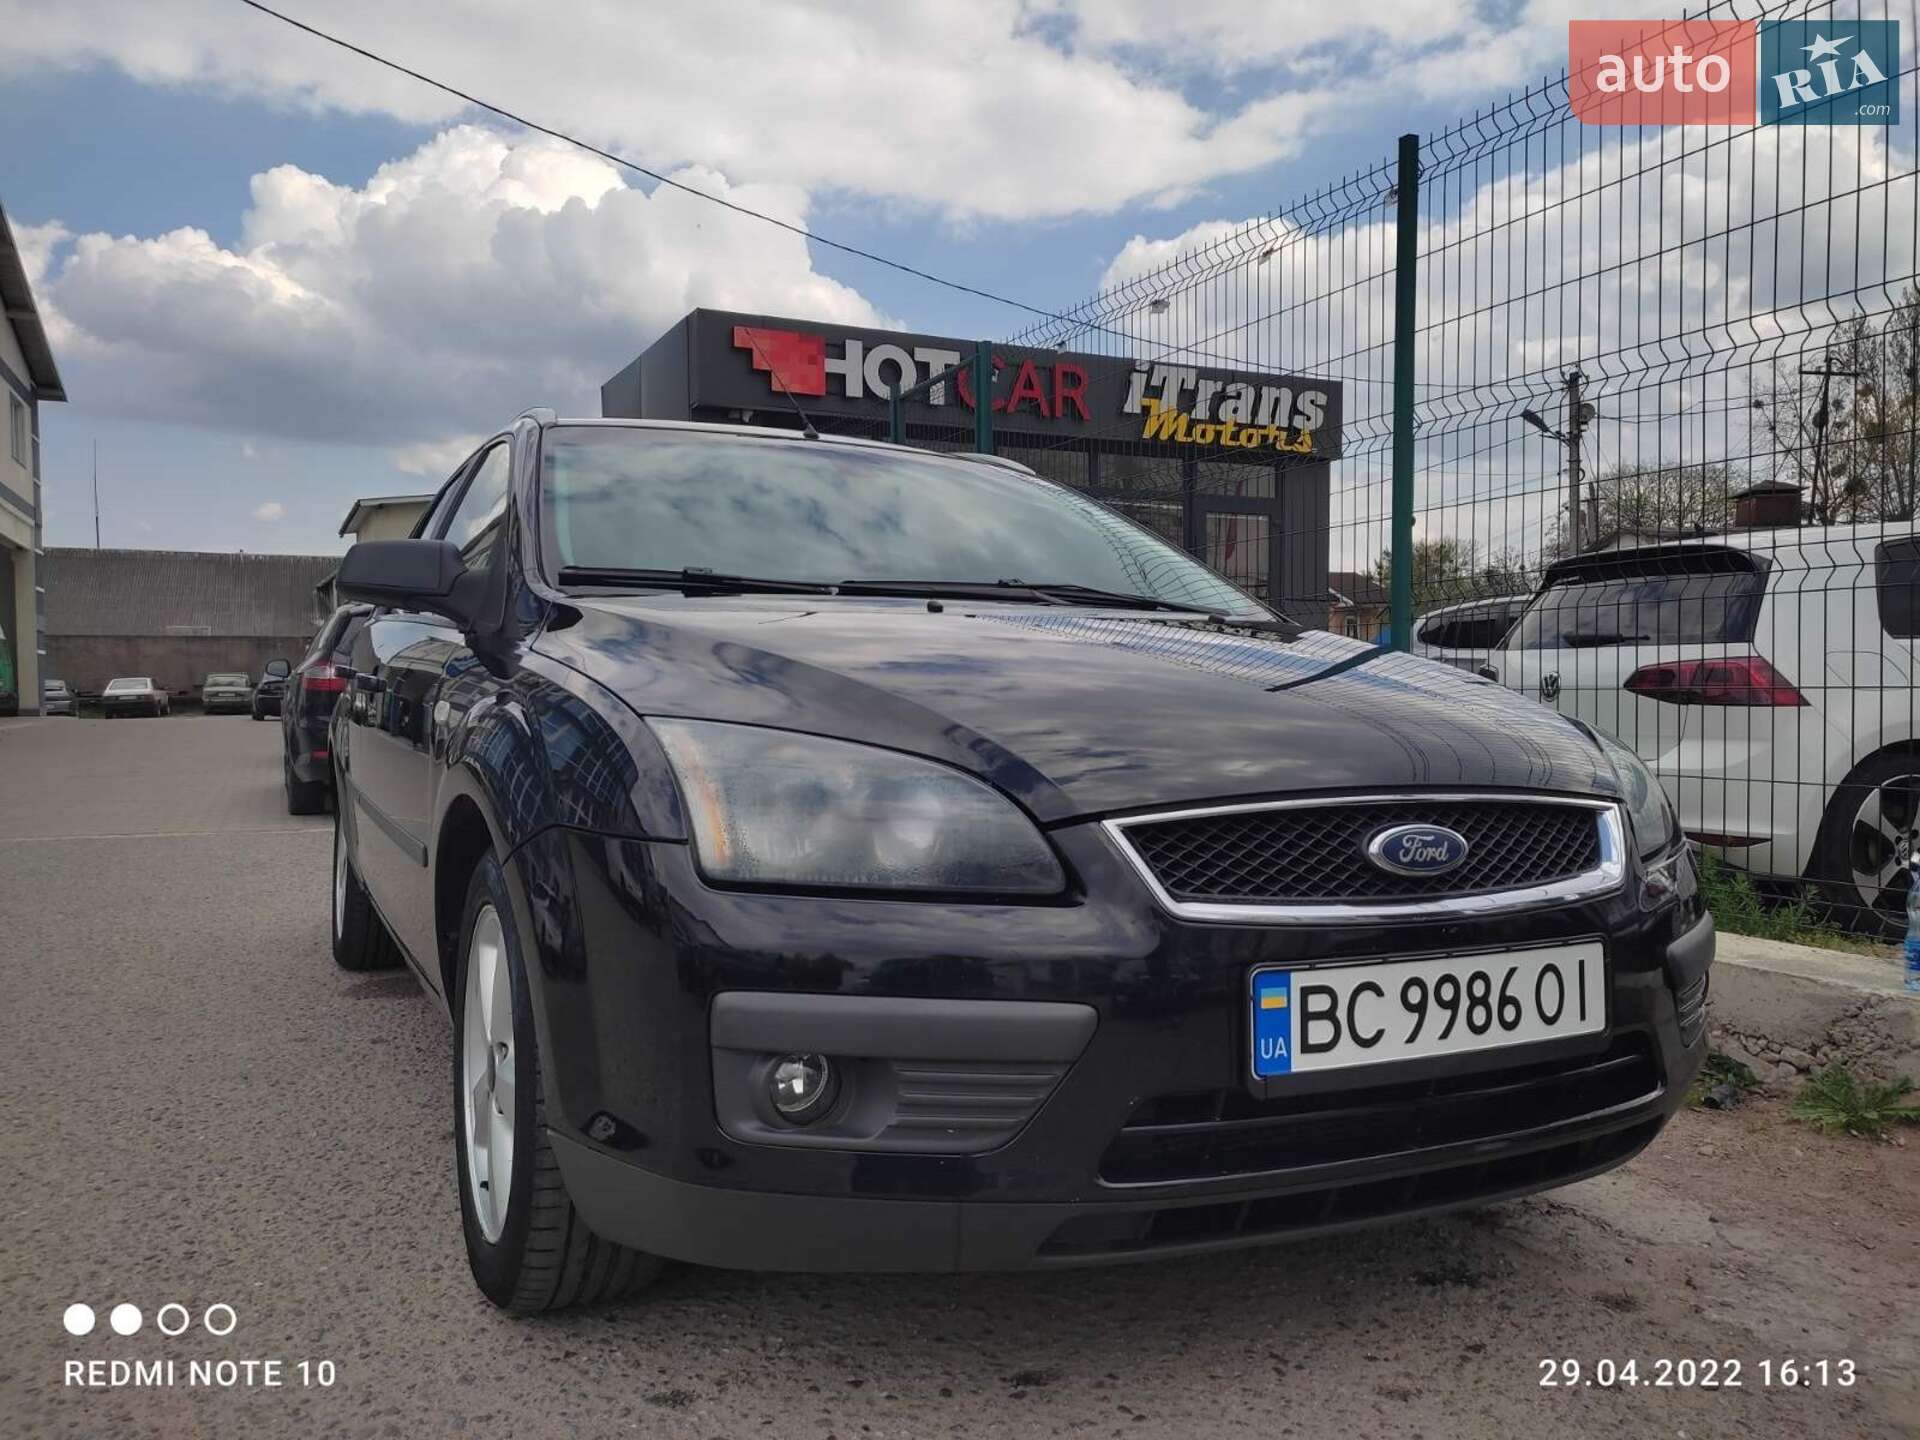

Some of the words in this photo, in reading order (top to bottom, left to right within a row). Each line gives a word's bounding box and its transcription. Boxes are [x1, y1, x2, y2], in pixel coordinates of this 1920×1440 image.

[1123, 359, 1328, 431] iTrans
[1141, 397, 1313, 453] Motors
[1400, 834, 1449, 862] Ford
[1260, 1036, 1288, 1059] UA
